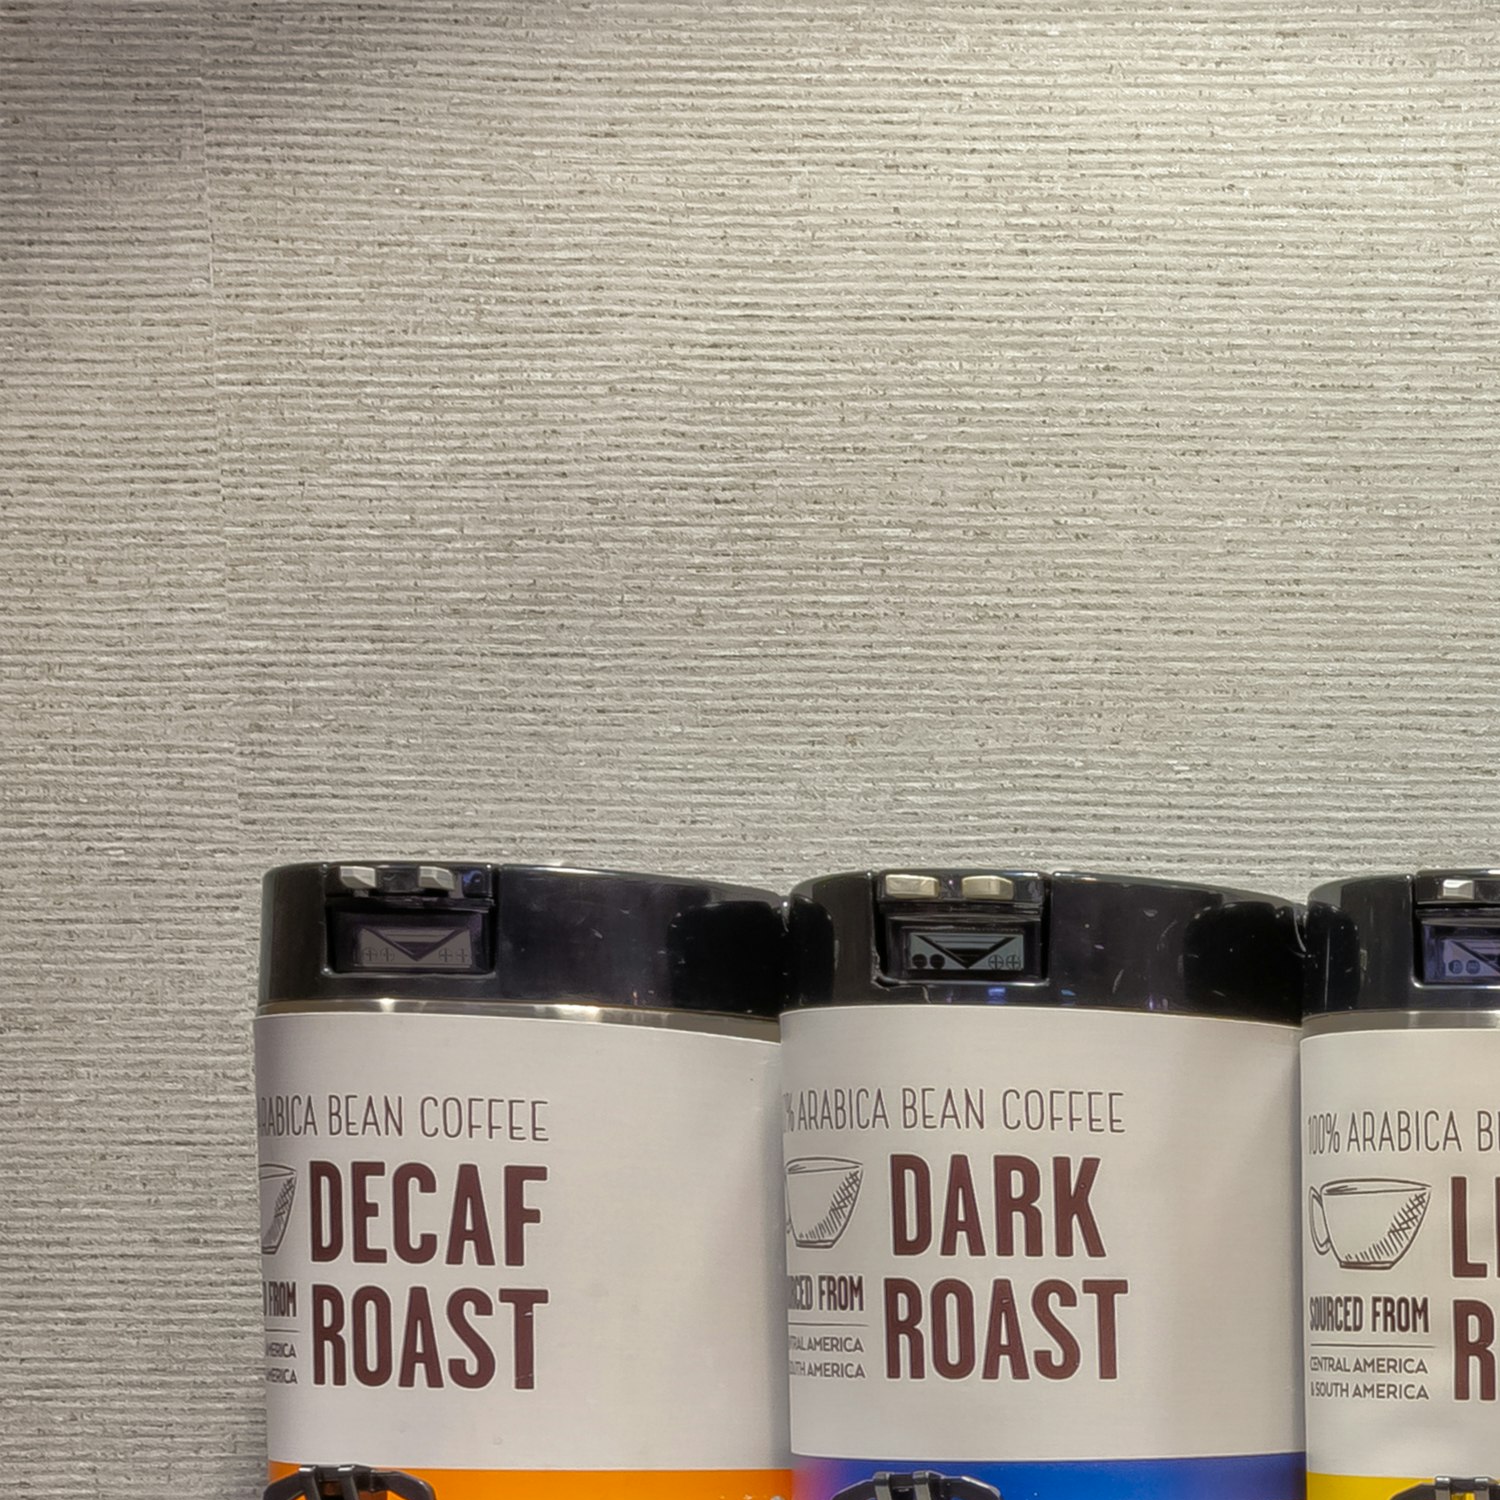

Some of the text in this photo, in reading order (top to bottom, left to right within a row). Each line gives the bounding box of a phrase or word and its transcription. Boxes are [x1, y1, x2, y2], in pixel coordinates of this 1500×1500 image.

[258, 1094, 550, 1142] RABICA BEAN COFFEE
[797, 1087, 890, 1131] ARABICA
[902, 1087, 984, 1130] BEAN
[1001, 1088, 1126, 1133] COFFEE
[1308, 1112, 1341, 1155] 100%
[1346, 1110, 1463, 1153] ARABICA
[309, 1160, 549, 1267] DECAF
[890, 1153, 1107, 1258] DARK
[269, 1280, 297, 1317] FROM
[818, 1275, 865, 1311] FROM
[883, 1277, 1130, 1381] ROAST
[1309, 1295, 1430, 1333] SOURCED FROM
[311, 1283, 550, 1391] ROAST
[807, 1336, 865, 1353] AMERICA
[808, 1362, 866, 1378] AMERICA
[1310, 1356, 1429, 1374] CENTRAL AMERICA
[1316, 1381, 1350, 1398] SOUTH
[1352, 1383, 1430, 1400] AMERICA
